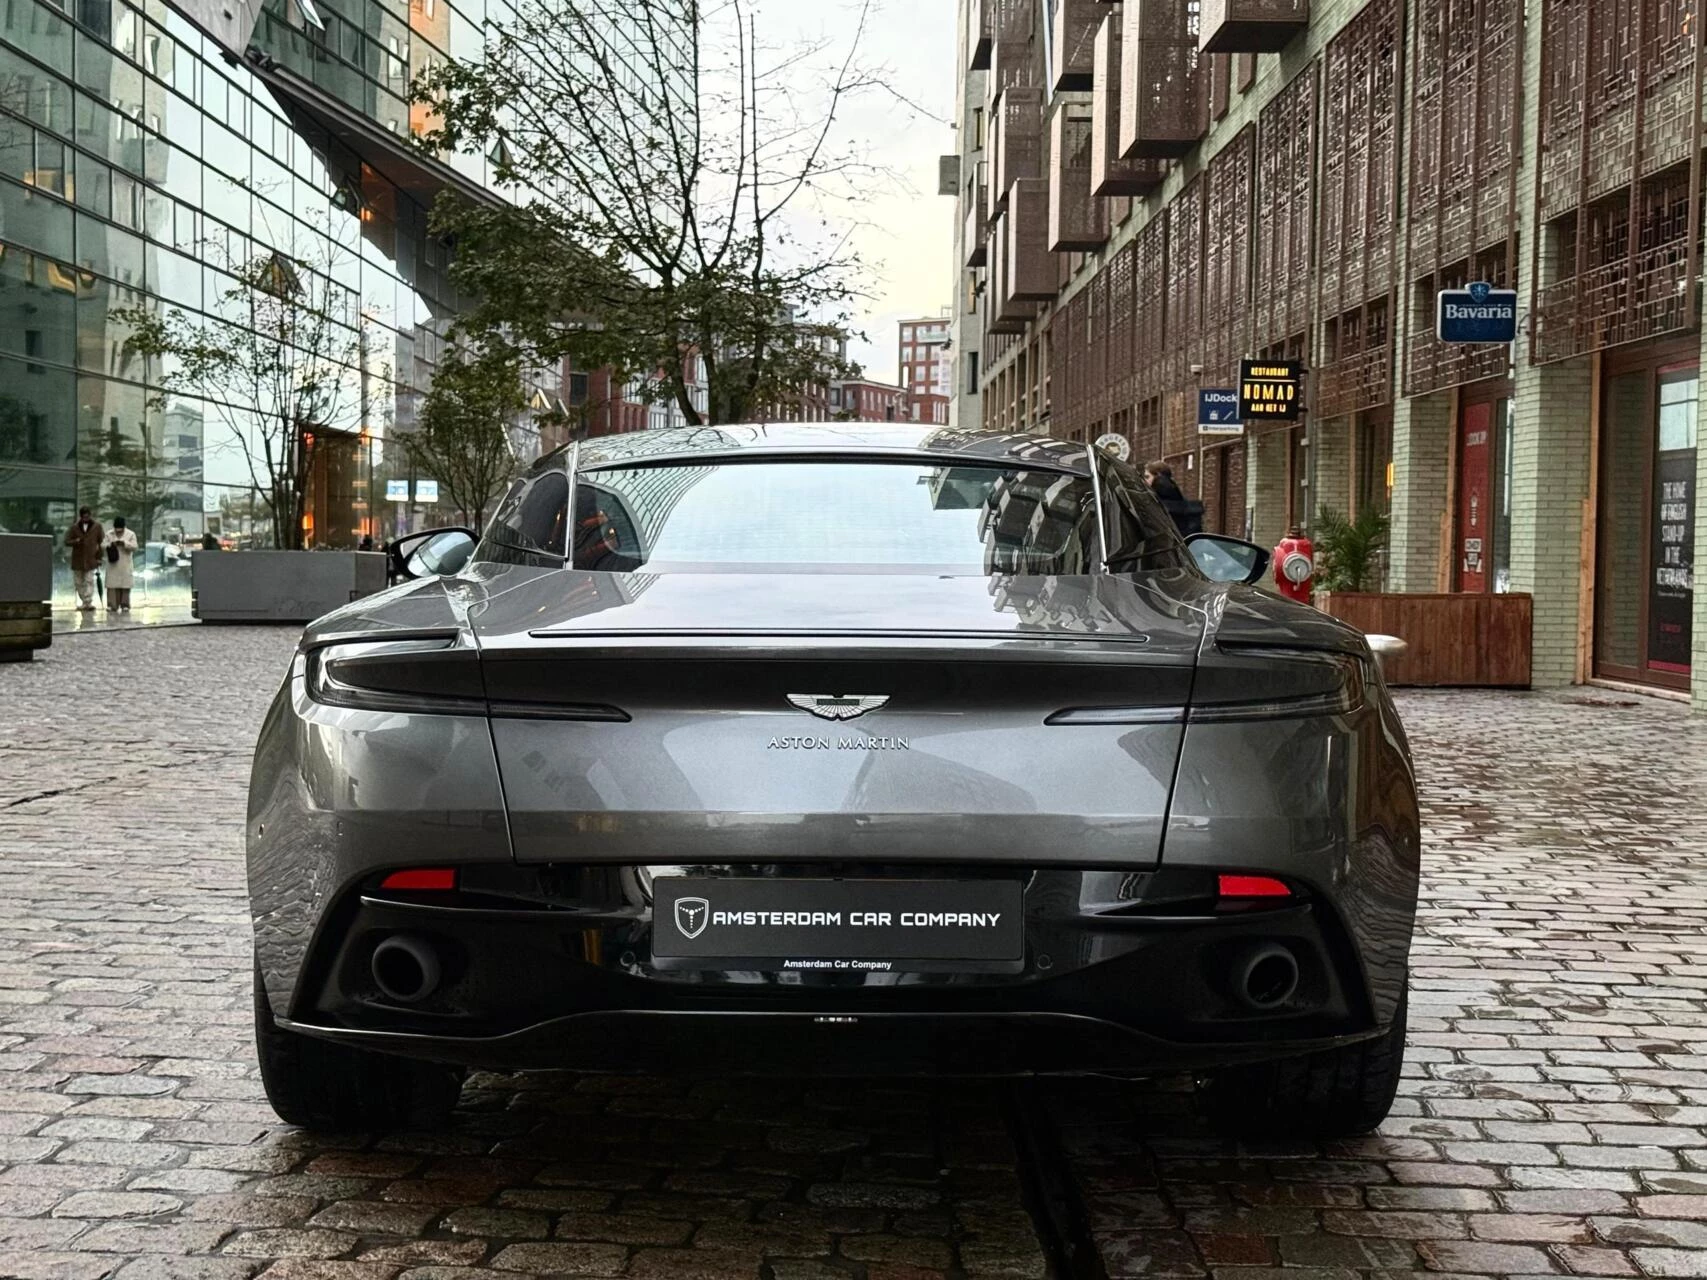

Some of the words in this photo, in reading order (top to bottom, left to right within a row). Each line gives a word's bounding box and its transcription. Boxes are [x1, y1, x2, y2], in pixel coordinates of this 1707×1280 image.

[1445, 303, 1512, 319] Bavaria
[1250, 367, 1289, 376] RESTAURANT
[1204, 393, 1238, 402] IJDock
[1243, 384, 1294, 401] NOMAD
[767, 736, 829, 749] ASTON
[838, 736, 909, 750] MARTIN
[713, 911, 841, 925] AMSTERDAM
[850, 912, 892, 926] CAR
[900, 912, 1001, 926] COMPANY
[783, 960, 832, 968] Amsterdam
[834, 960, 850, 968] Car
[851, 960, 892, 970] Company
